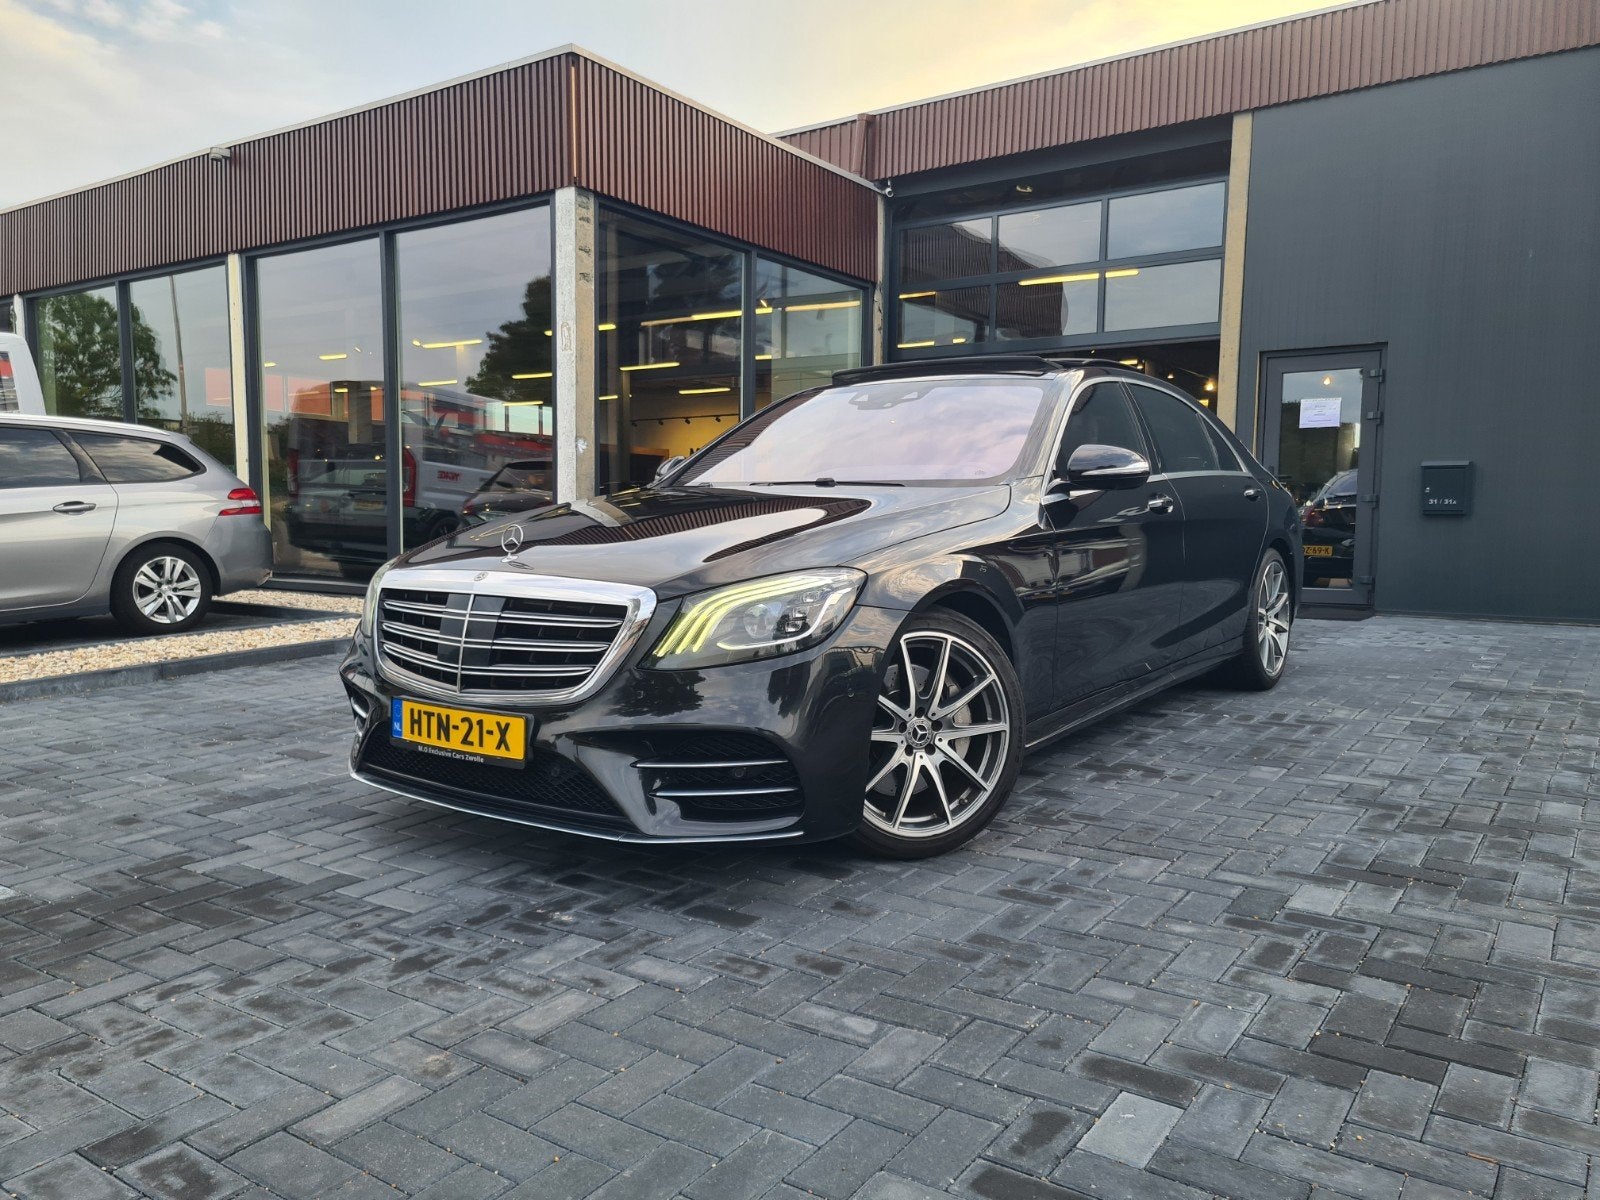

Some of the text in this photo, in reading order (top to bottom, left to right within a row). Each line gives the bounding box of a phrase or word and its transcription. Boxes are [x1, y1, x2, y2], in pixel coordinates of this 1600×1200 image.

[393, 721, 402, 732] NL
[409, 707, 511, 752] HTN-21-X
[428, 747, 452, 758] Exclusive
[452, 752, 465, 760] Cars
[465, 754, 484, 763] Zwolle
